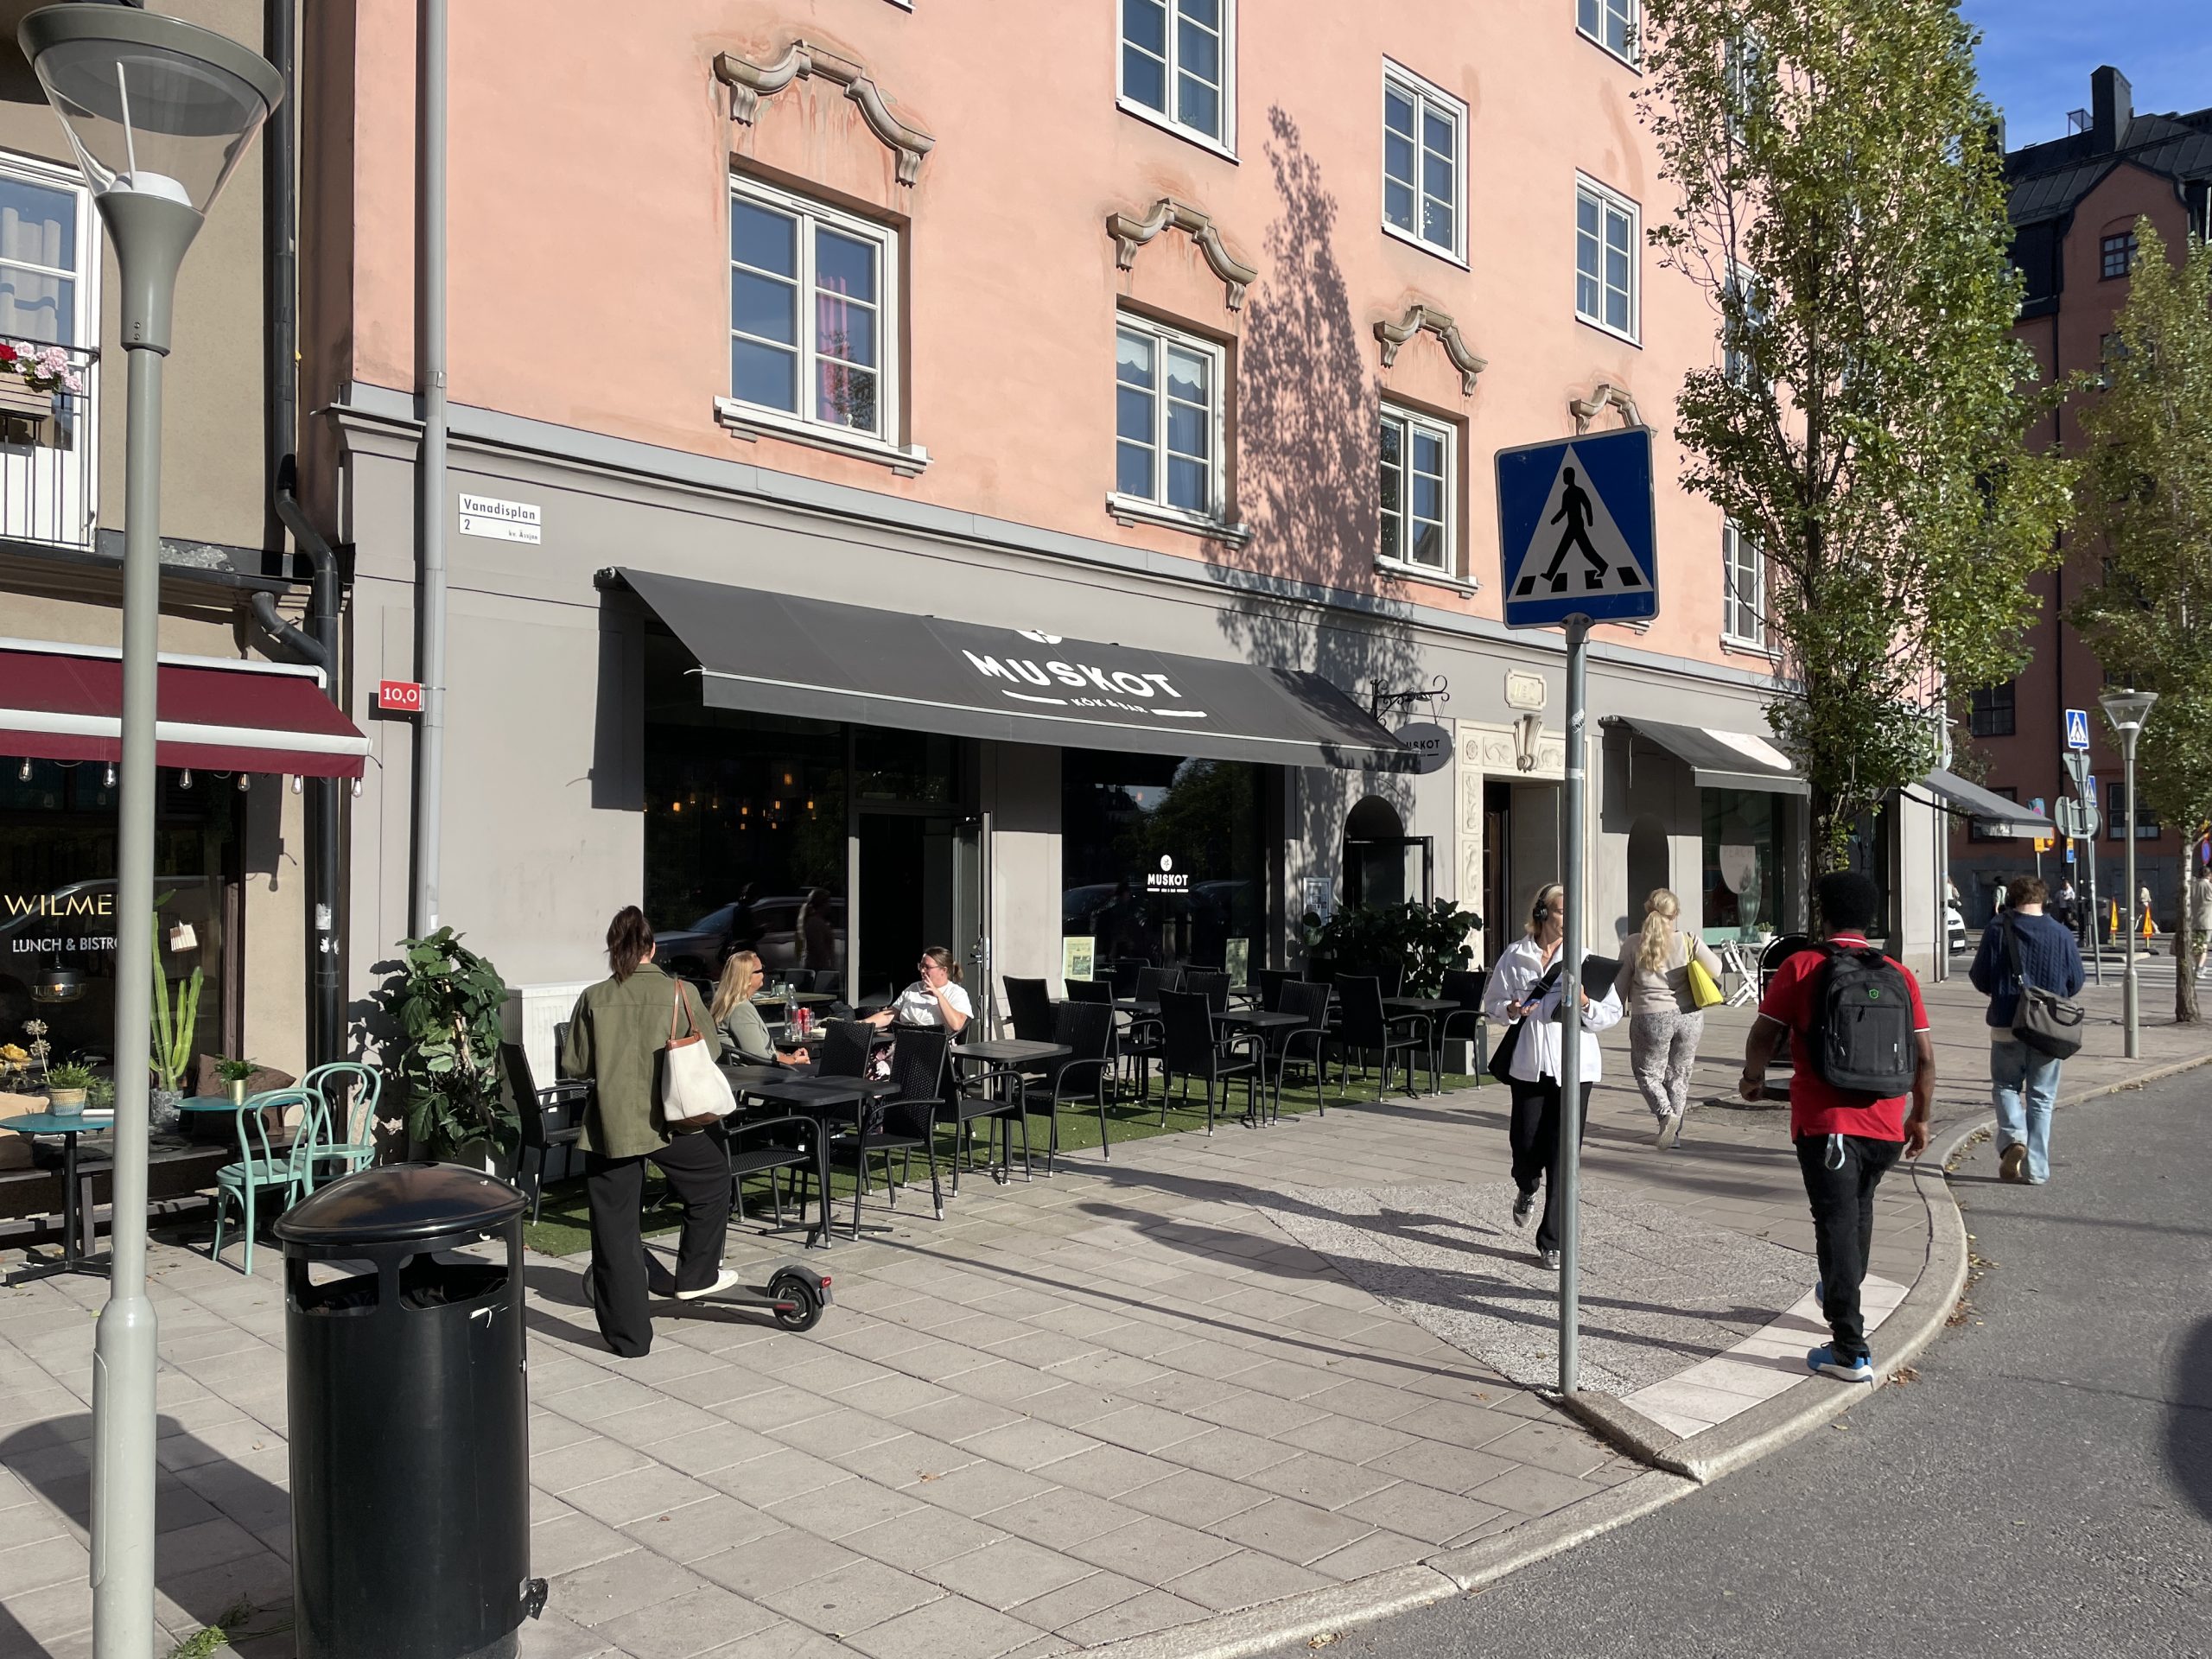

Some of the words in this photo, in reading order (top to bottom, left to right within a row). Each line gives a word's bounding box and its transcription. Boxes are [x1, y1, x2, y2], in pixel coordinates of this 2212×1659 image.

[464, 498, 536, 519] Vanadisplan
[464, 518, 470, 530] 2
[962, 649, 1182, 698] MUSKOT
[384, 687, 417, 704] 10,0
[1071, 697, 1107, 708] KÖK
[1105, 698, 1120, 708] &
[1147, 873, 1188, 887] MUSKOT
[4, 894, 118, 916] WILME
[12, 938, 62, 952] LUNCH
[66, 938, 76, 950] &
